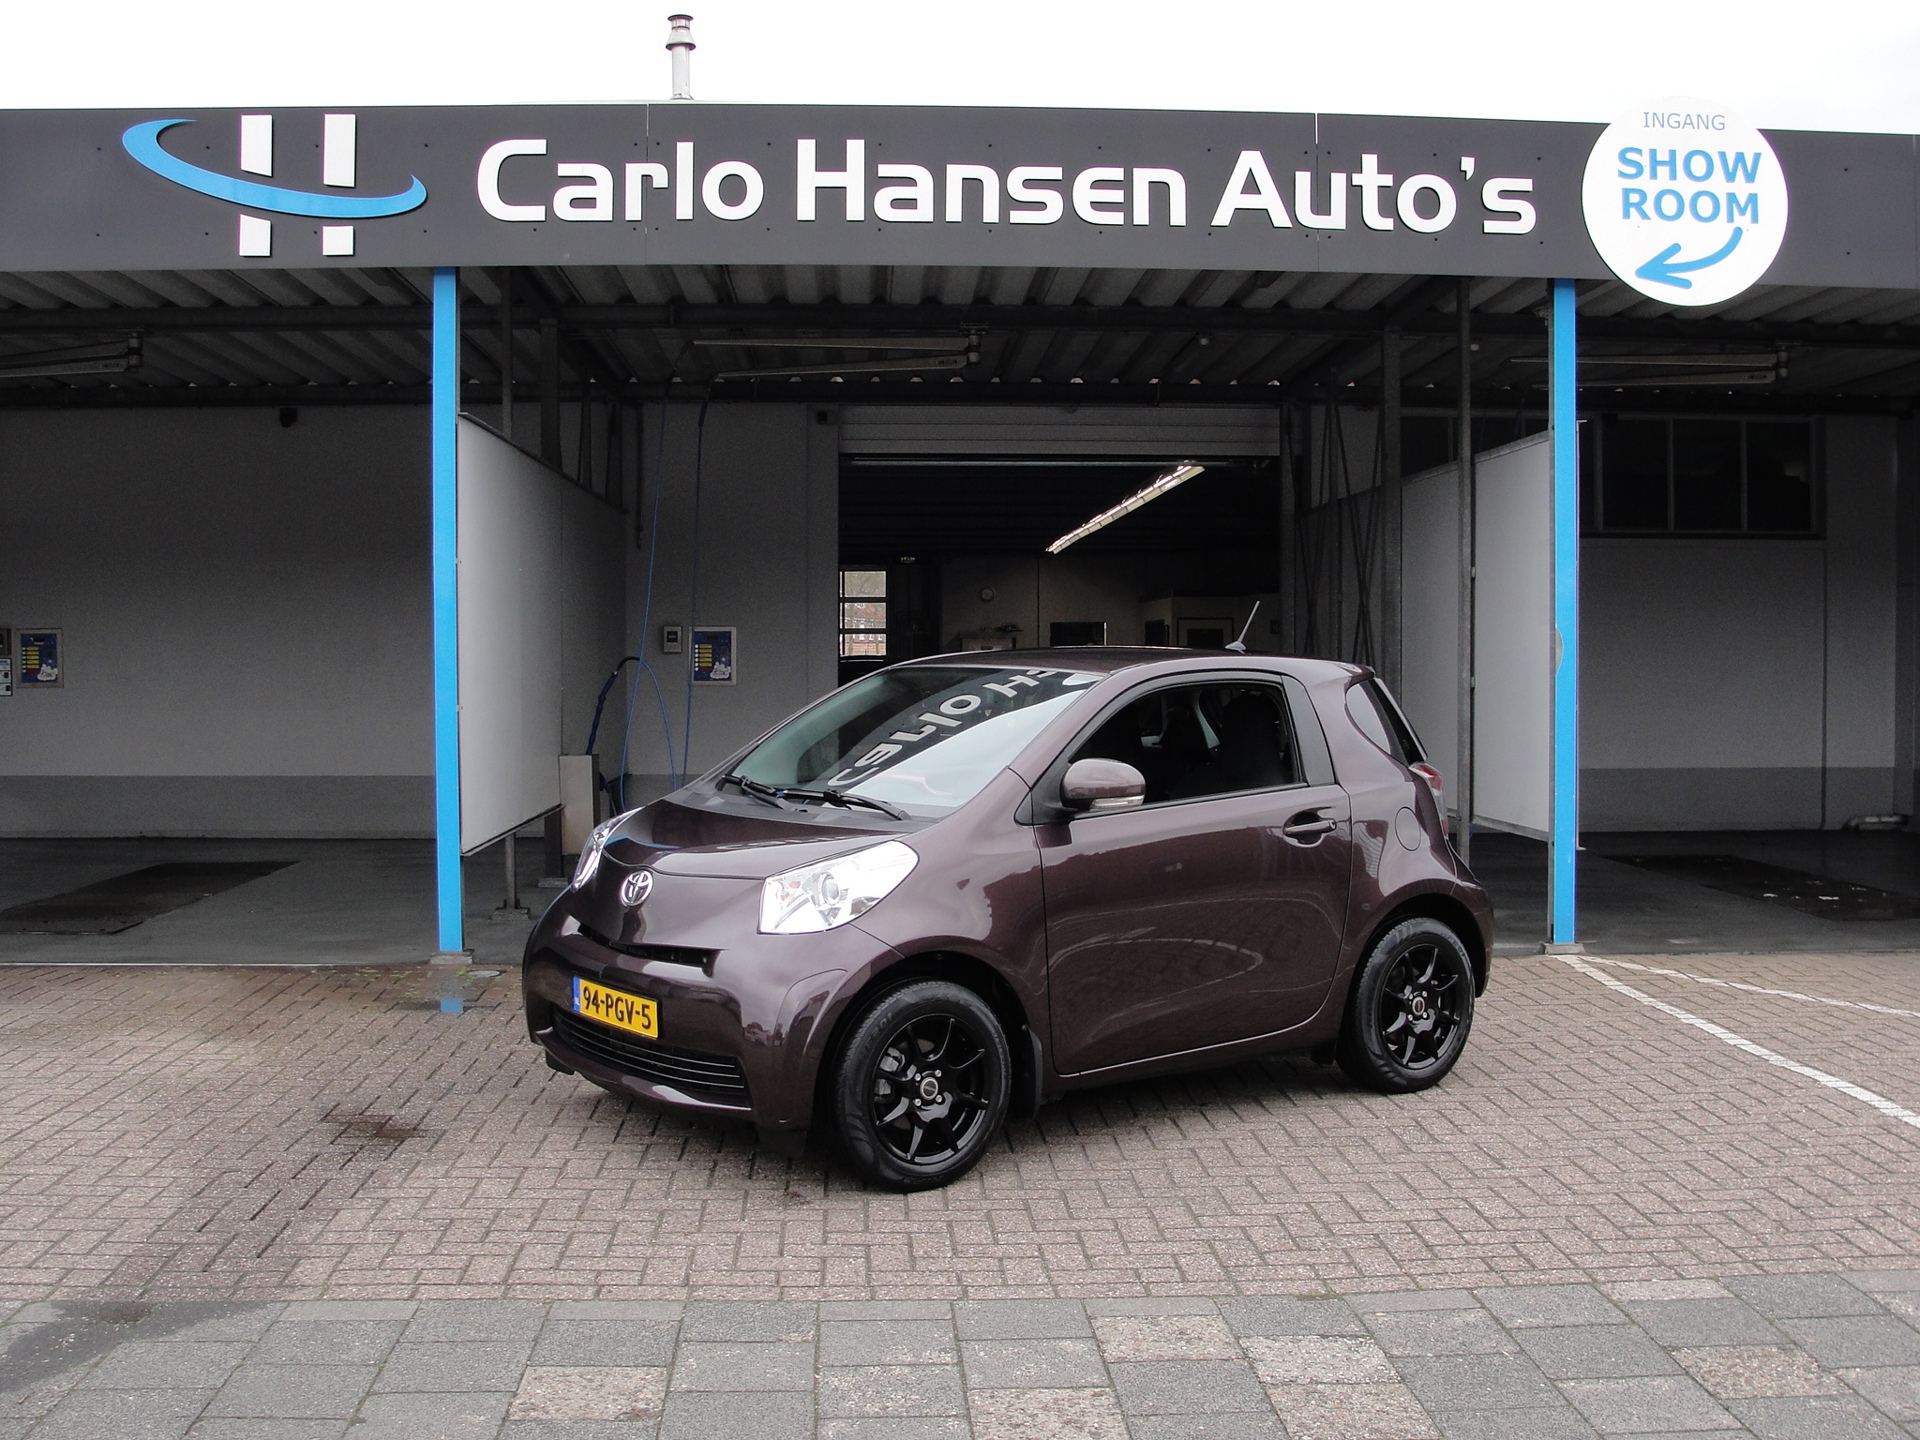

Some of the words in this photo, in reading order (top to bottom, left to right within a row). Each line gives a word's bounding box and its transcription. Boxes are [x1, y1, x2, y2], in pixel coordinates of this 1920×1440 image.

[1643, 112, 1726, 131] INGANG
[1617, 147, 1762, 184] SHOW
[477, 139, 765, 222] Carlo
[797, 138, 1187, 226] Hansen
[1210, 150, 1537, 234] Auto's
[1621, 187, 1759, 224] ROOM
[583, 986, 652, 1030] 94-PGV-5
